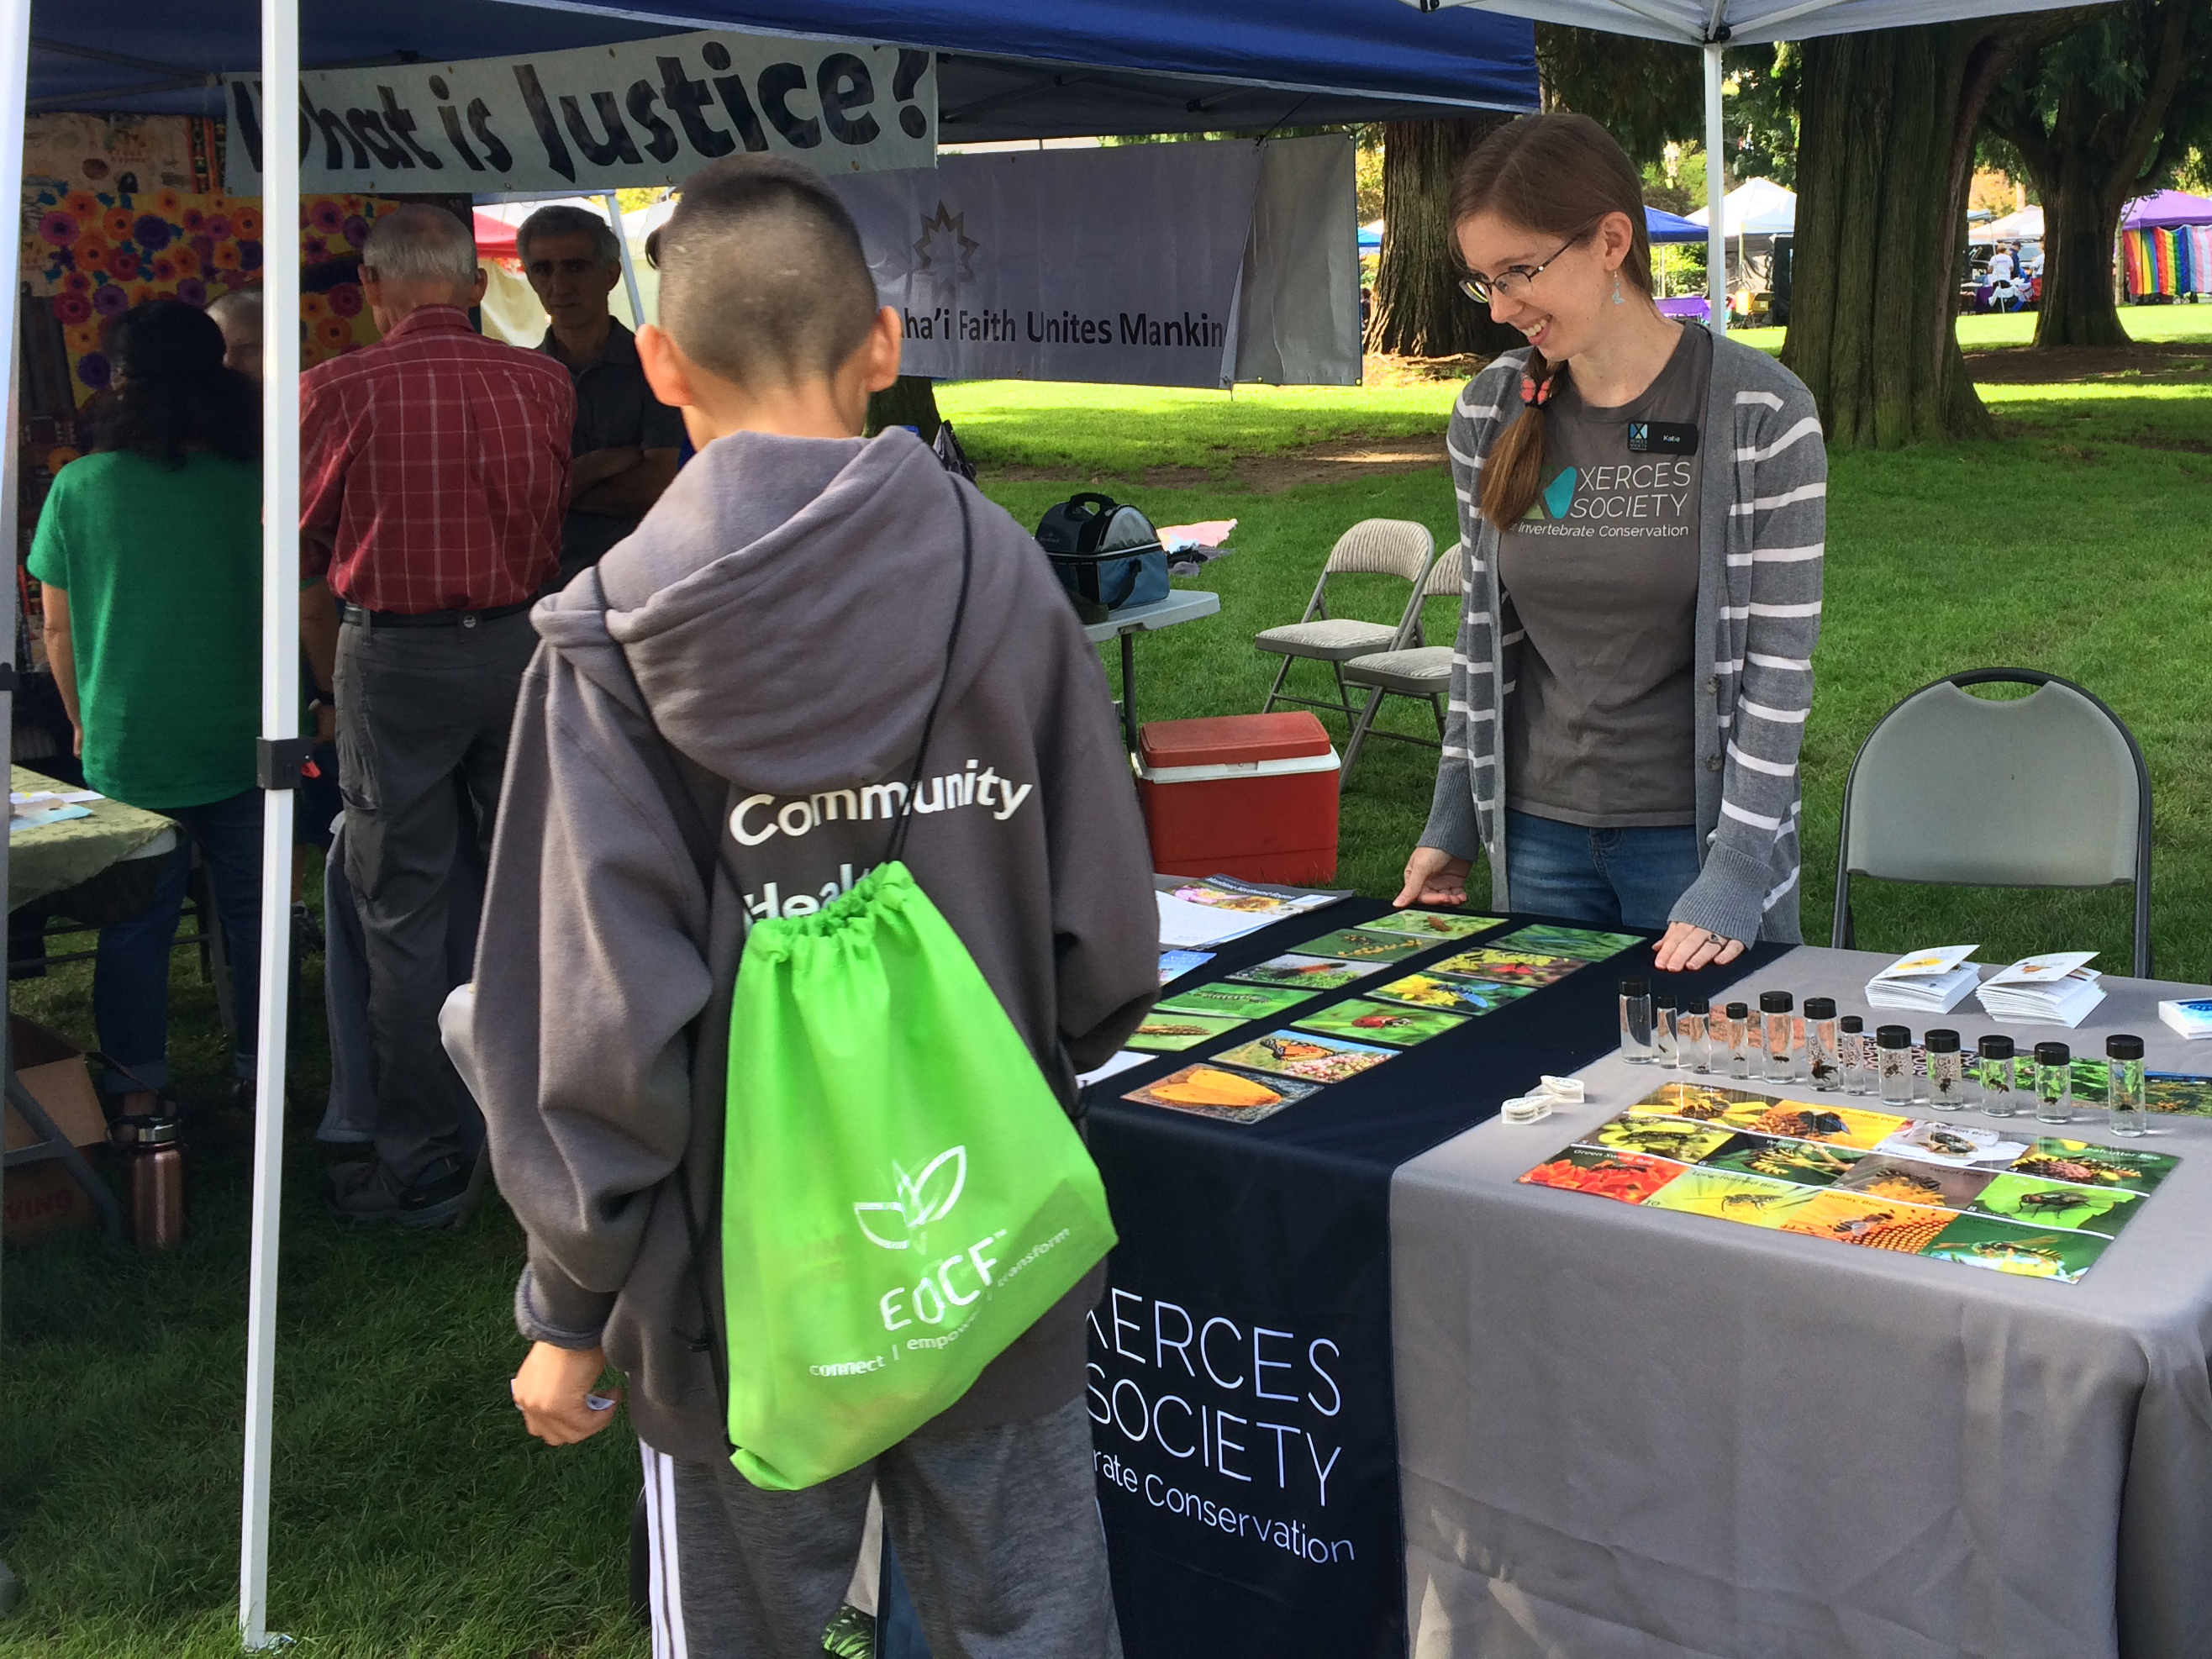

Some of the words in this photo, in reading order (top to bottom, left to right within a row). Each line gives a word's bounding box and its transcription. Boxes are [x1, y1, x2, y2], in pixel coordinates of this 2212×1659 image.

[427, 74, 514, 173] is
[511, 41, 930, 183] Justice?
[900, 308, 951, 340] ha'i
[959, 308, 1016, 342] Faith
[1027, 310, 1112, 345] Unites
[1119, 312, 1226, 348] Mankin
[1663, 434, 1681, 443] Katie
[1577, 461, 1692, 492] XERCES
[1569, 492, 1688, 519] SOCIETY
[1518, 521, 1595, 537] Invertebrate
[1598, 524, 1689, 537] Conservation
[729, 758, 1034, 846] Community
[743, 863, 871, 935] Heal
[1841, 1109, 1878, 1119] Bumble
[1935, 1124, 1969, 1134] Mason
[1604, 1153, 1635, 1162] Sweat
[1825, 1193, 1858, 1203] Honey
[1862, 1199, 1883, 1208] Bee
[906, 1308, 981, 1350] empo
[998, 1228, 1071, 1288] transform
[1086, 1361, 1342, 1507] SOCIETY
[1093, 1448, 1139, 1493] rate
[1145, 1472, 1356, 1564] Conservation
